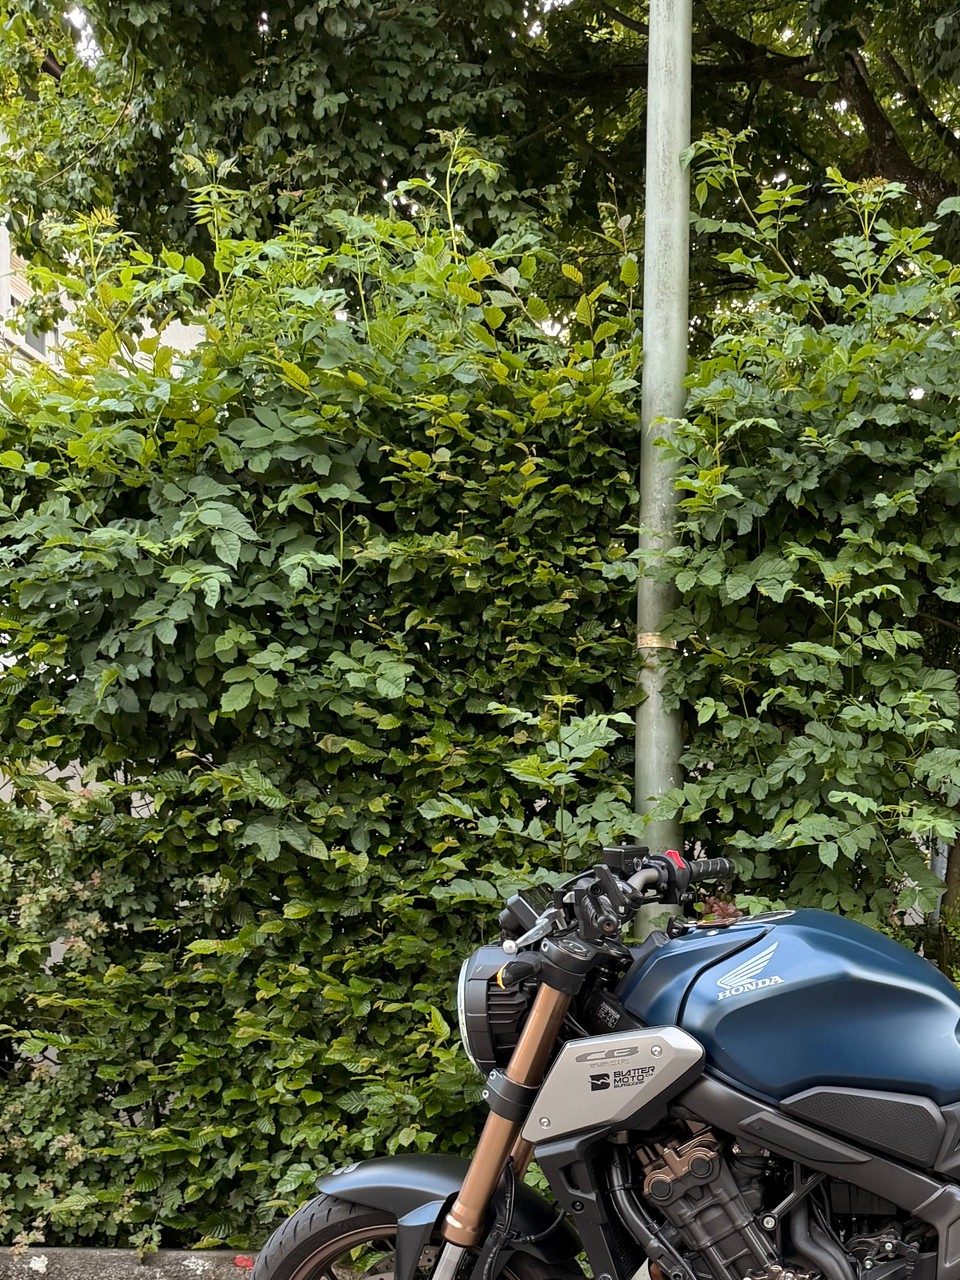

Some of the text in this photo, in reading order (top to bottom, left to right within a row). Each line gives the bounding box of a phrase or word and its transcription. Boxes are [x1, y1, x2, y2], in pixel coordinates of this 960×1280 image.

[717, 975, 785, 1001] HONDA
[575, 1046, 639, 1063] CB
[613, 1065, 656, 1078] BLATTER
[613, 1074, 645, 1085] MOTO
